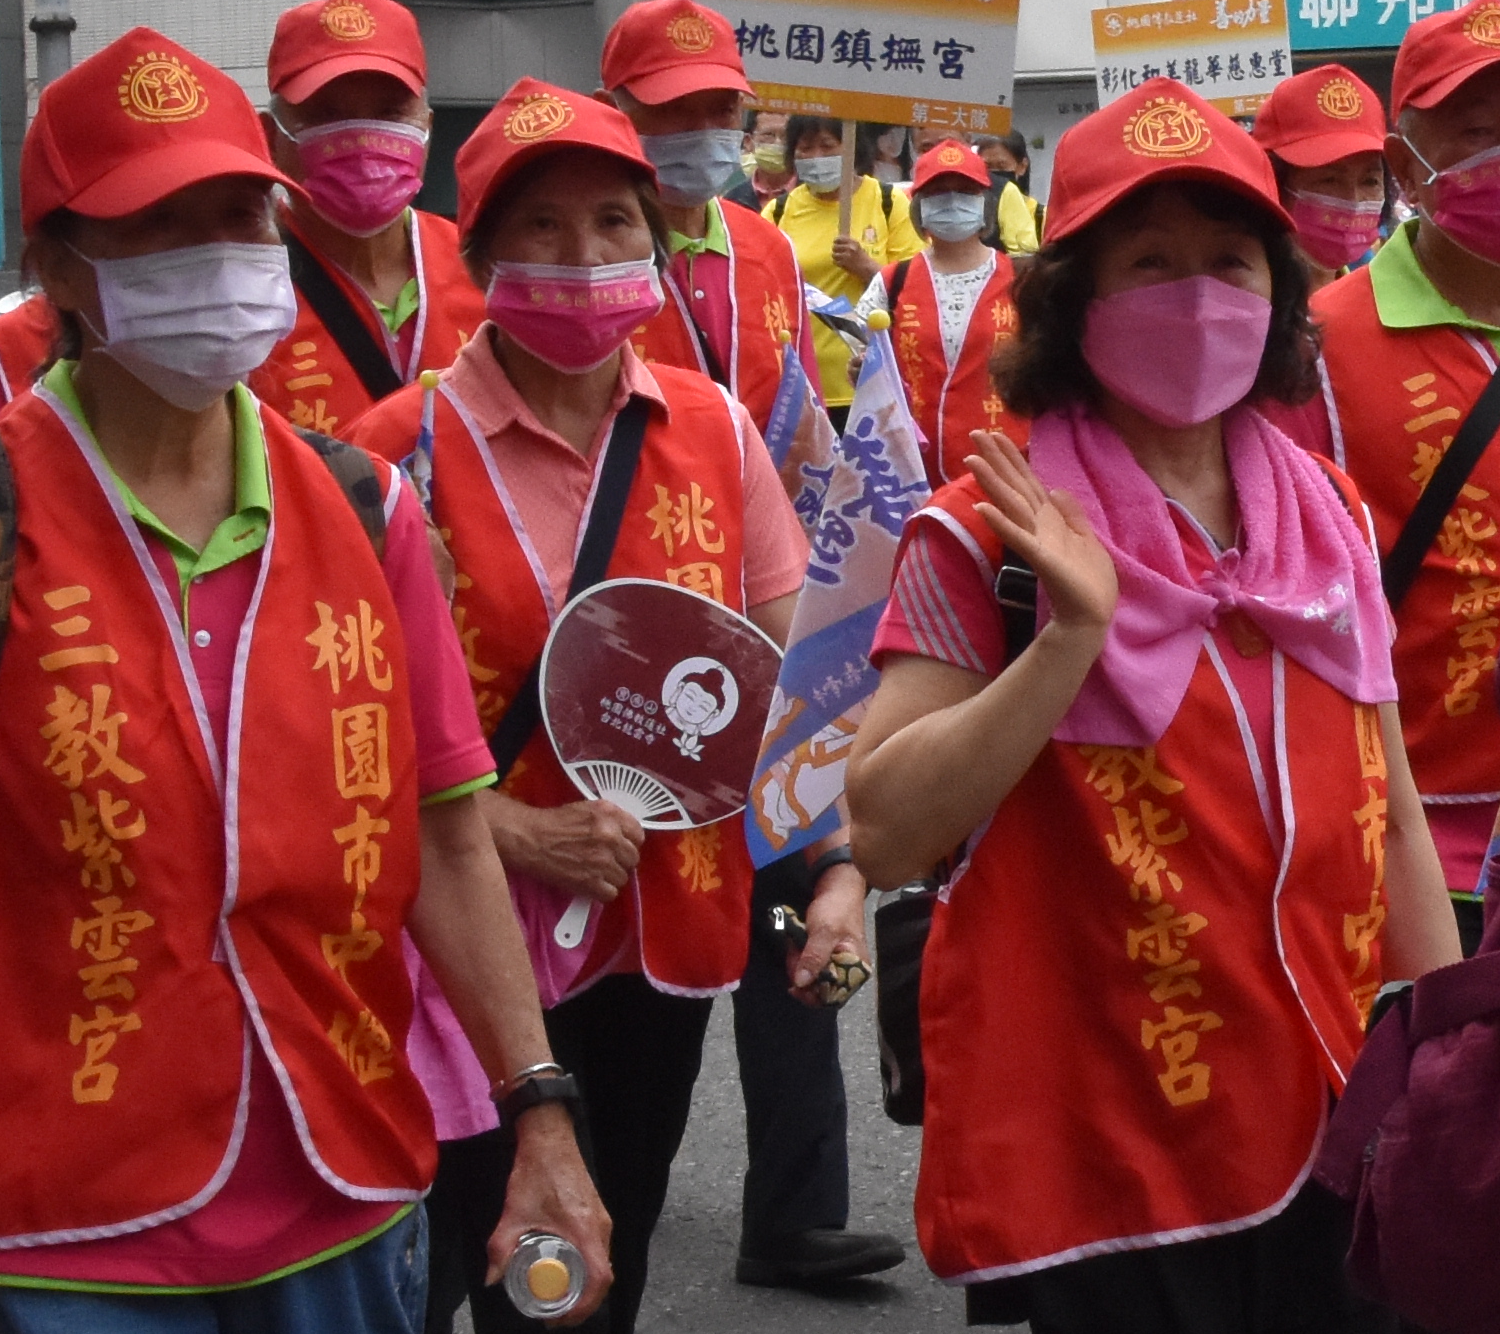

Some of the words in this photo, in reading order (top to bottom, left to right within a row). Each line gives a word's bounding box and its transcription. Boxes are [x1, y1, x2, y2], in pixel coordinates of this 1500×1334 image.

[734, 17, 976, 81] 桃園鎮撫宮
[911, 101, 990, 130] 第二大隊
[39, 584, 155, 1105] 三教紫雲宮
